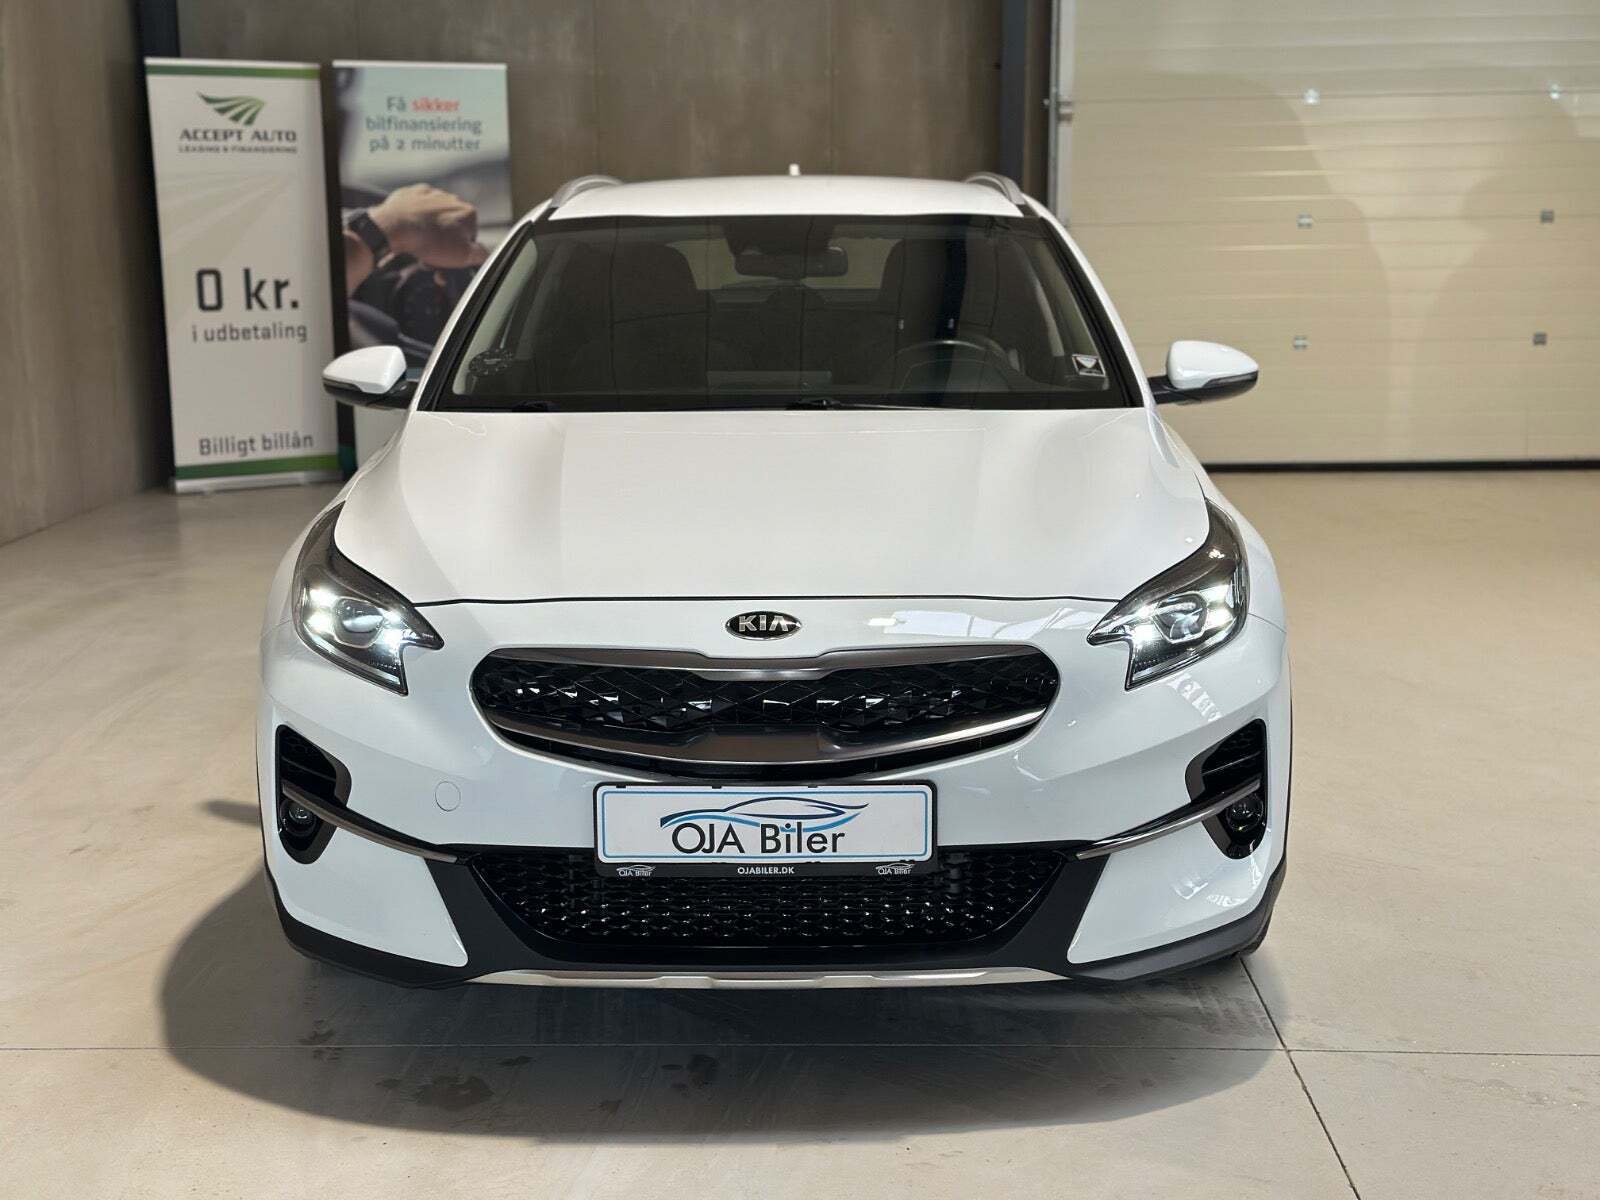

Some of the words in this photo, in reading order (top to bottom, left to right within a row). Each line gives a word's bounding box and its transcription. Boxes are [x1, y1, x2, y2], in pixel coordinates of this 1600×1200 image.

[387, 96, 406, 111] Få
[411, 97, 459, 112] sikker
[366, 116, 482, 135] bilfinansiering
[179, 129, 242, 141] ACCEPT
[251, 130, 297, 142] AUTO
[369, 136, 389, 153] på
[397, 139, 405, 150] 2
[411, 137, 480, 151] minutter
[243, 268, 299, 311] kr.
[192, 324, 198, 342] i
[203, 322, 307, 343] udbetaling
[199, 436, 256, 457] Billigt
[262, 431, 313, 452] billån
[739, 615, 789, 632] KIA
[671, 822, 746, 854] OJA
[760, 821, 846, 854] Biler
[737, 866, 795, 875] OJABILER.DK
